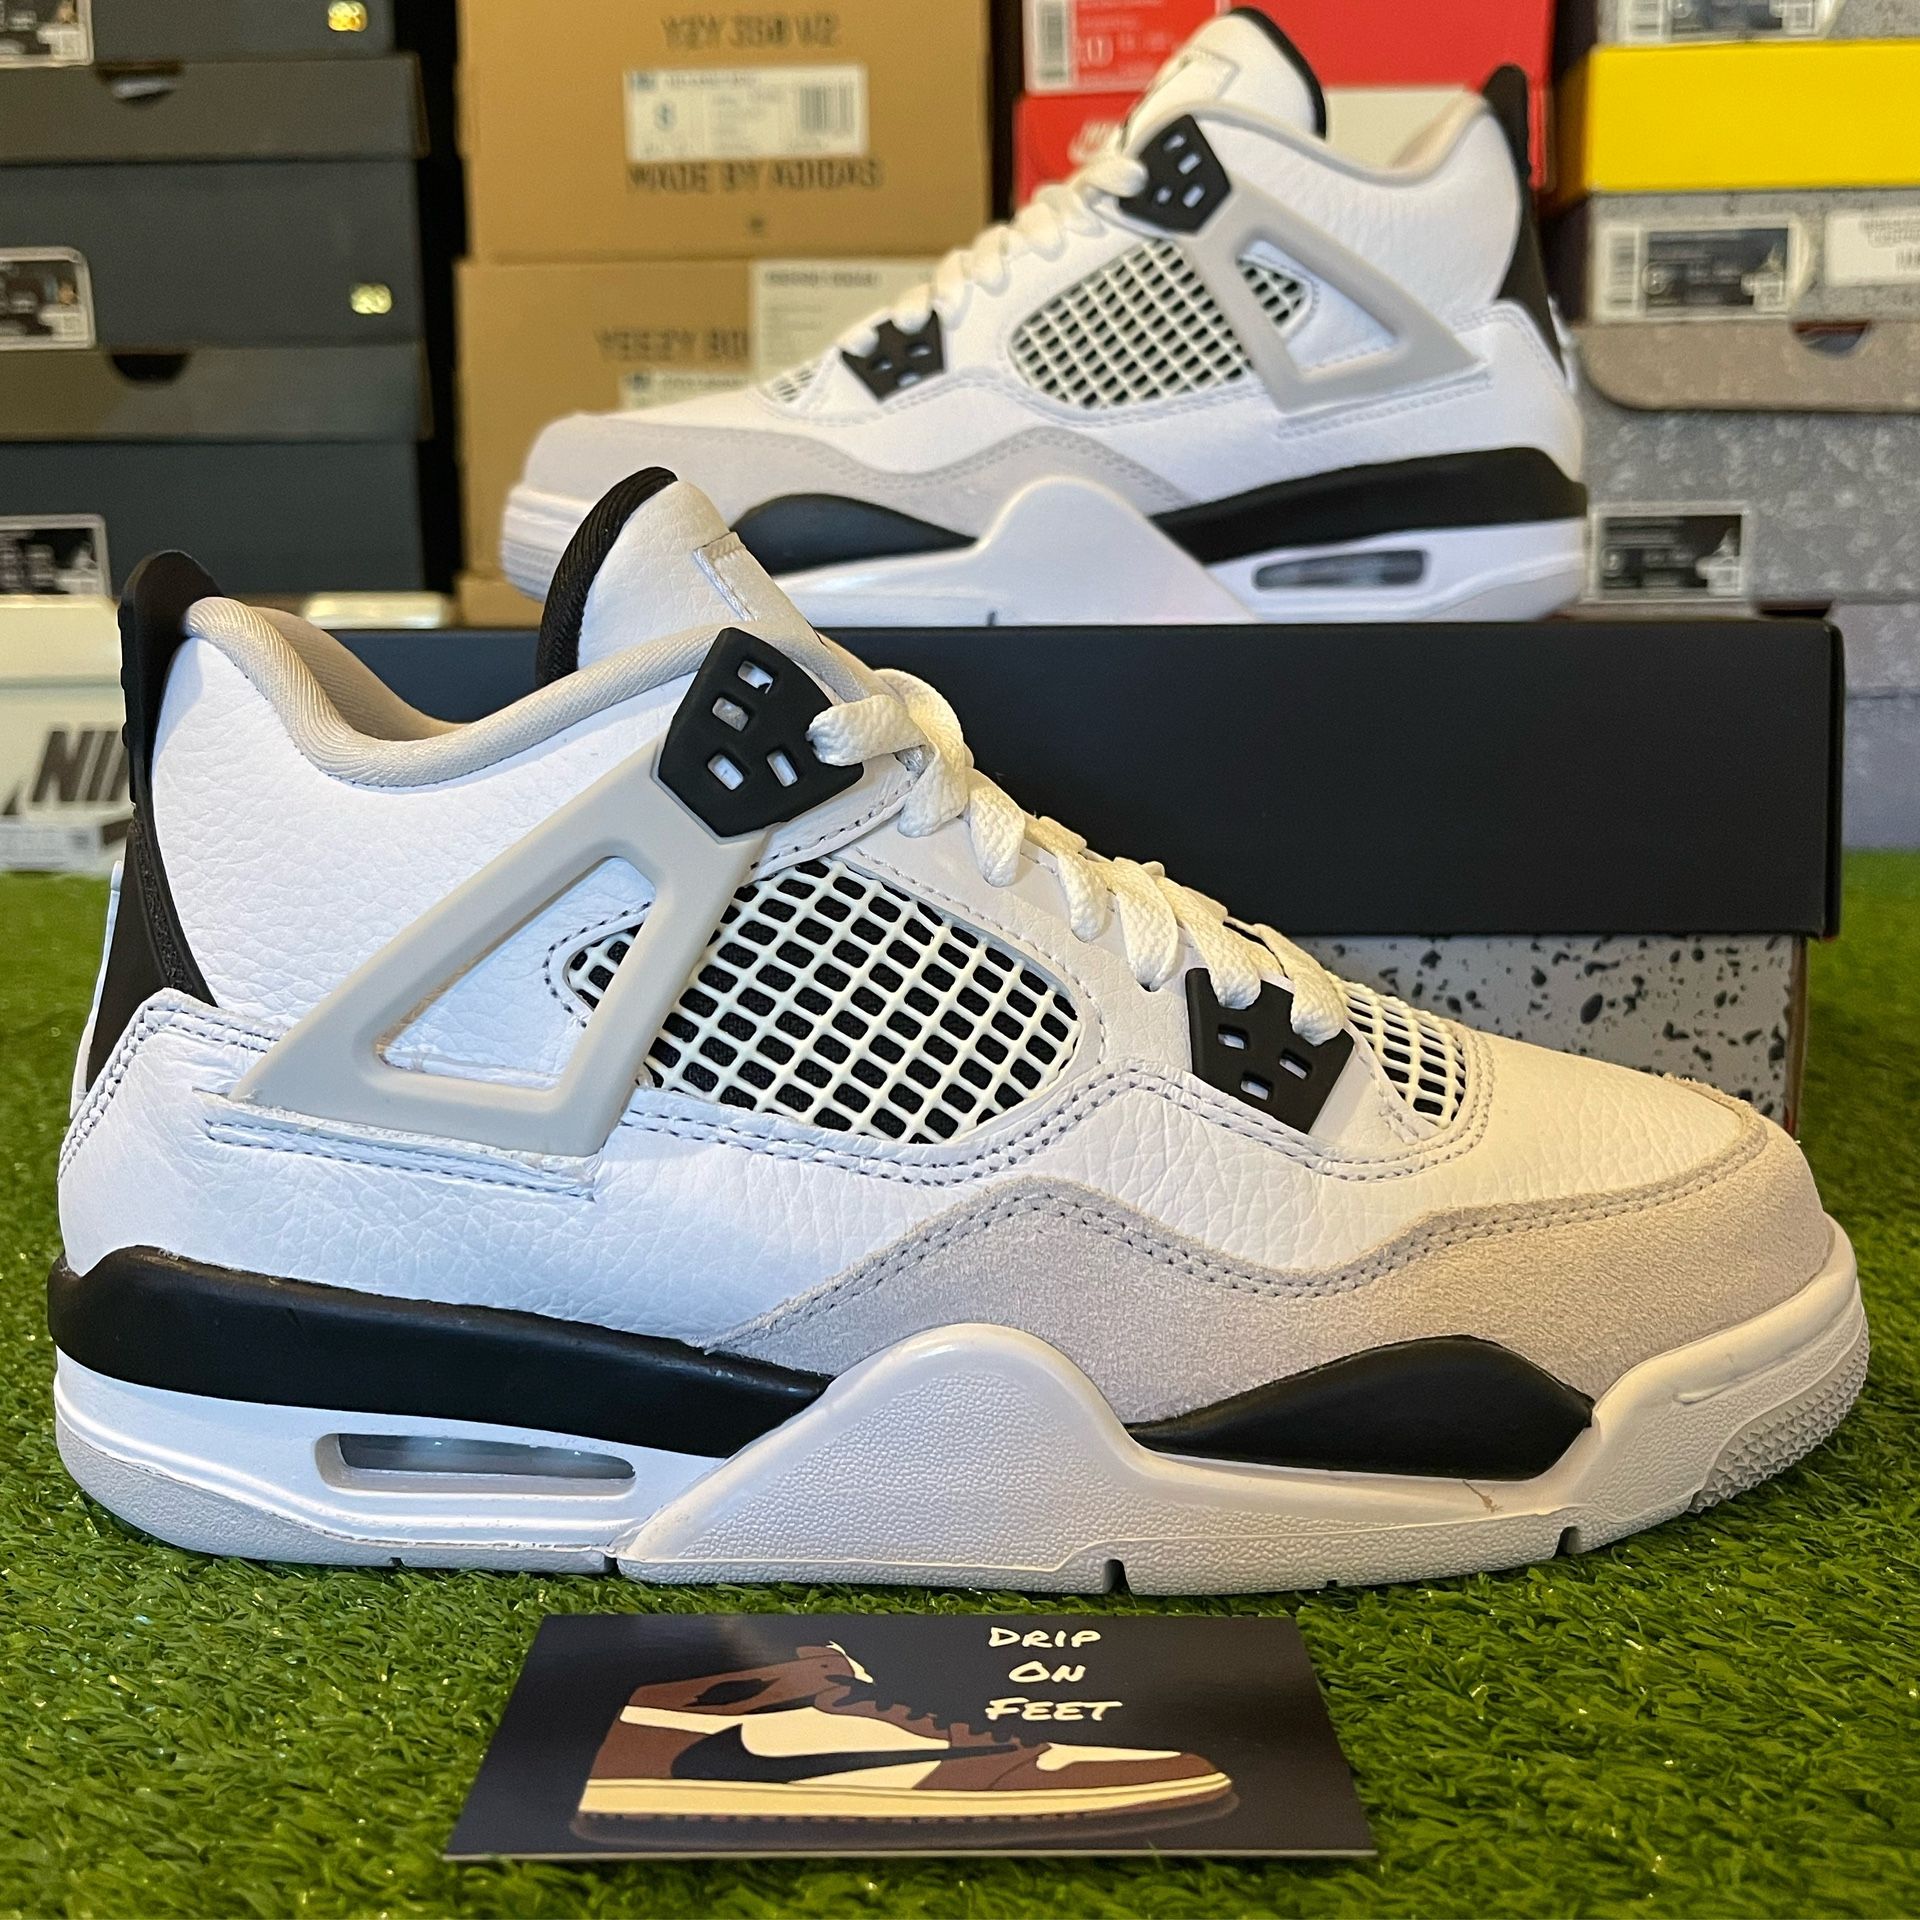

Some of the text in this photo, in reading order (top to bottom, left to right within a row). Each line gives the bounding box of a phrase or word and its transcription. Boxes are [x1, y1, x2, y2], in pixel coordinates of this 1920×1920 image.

[988, 1626, 1101, 1648] DRIP
[1008, 1660, 1086, 1683] ON
[984, 1697, 1122, 1721] FEET
